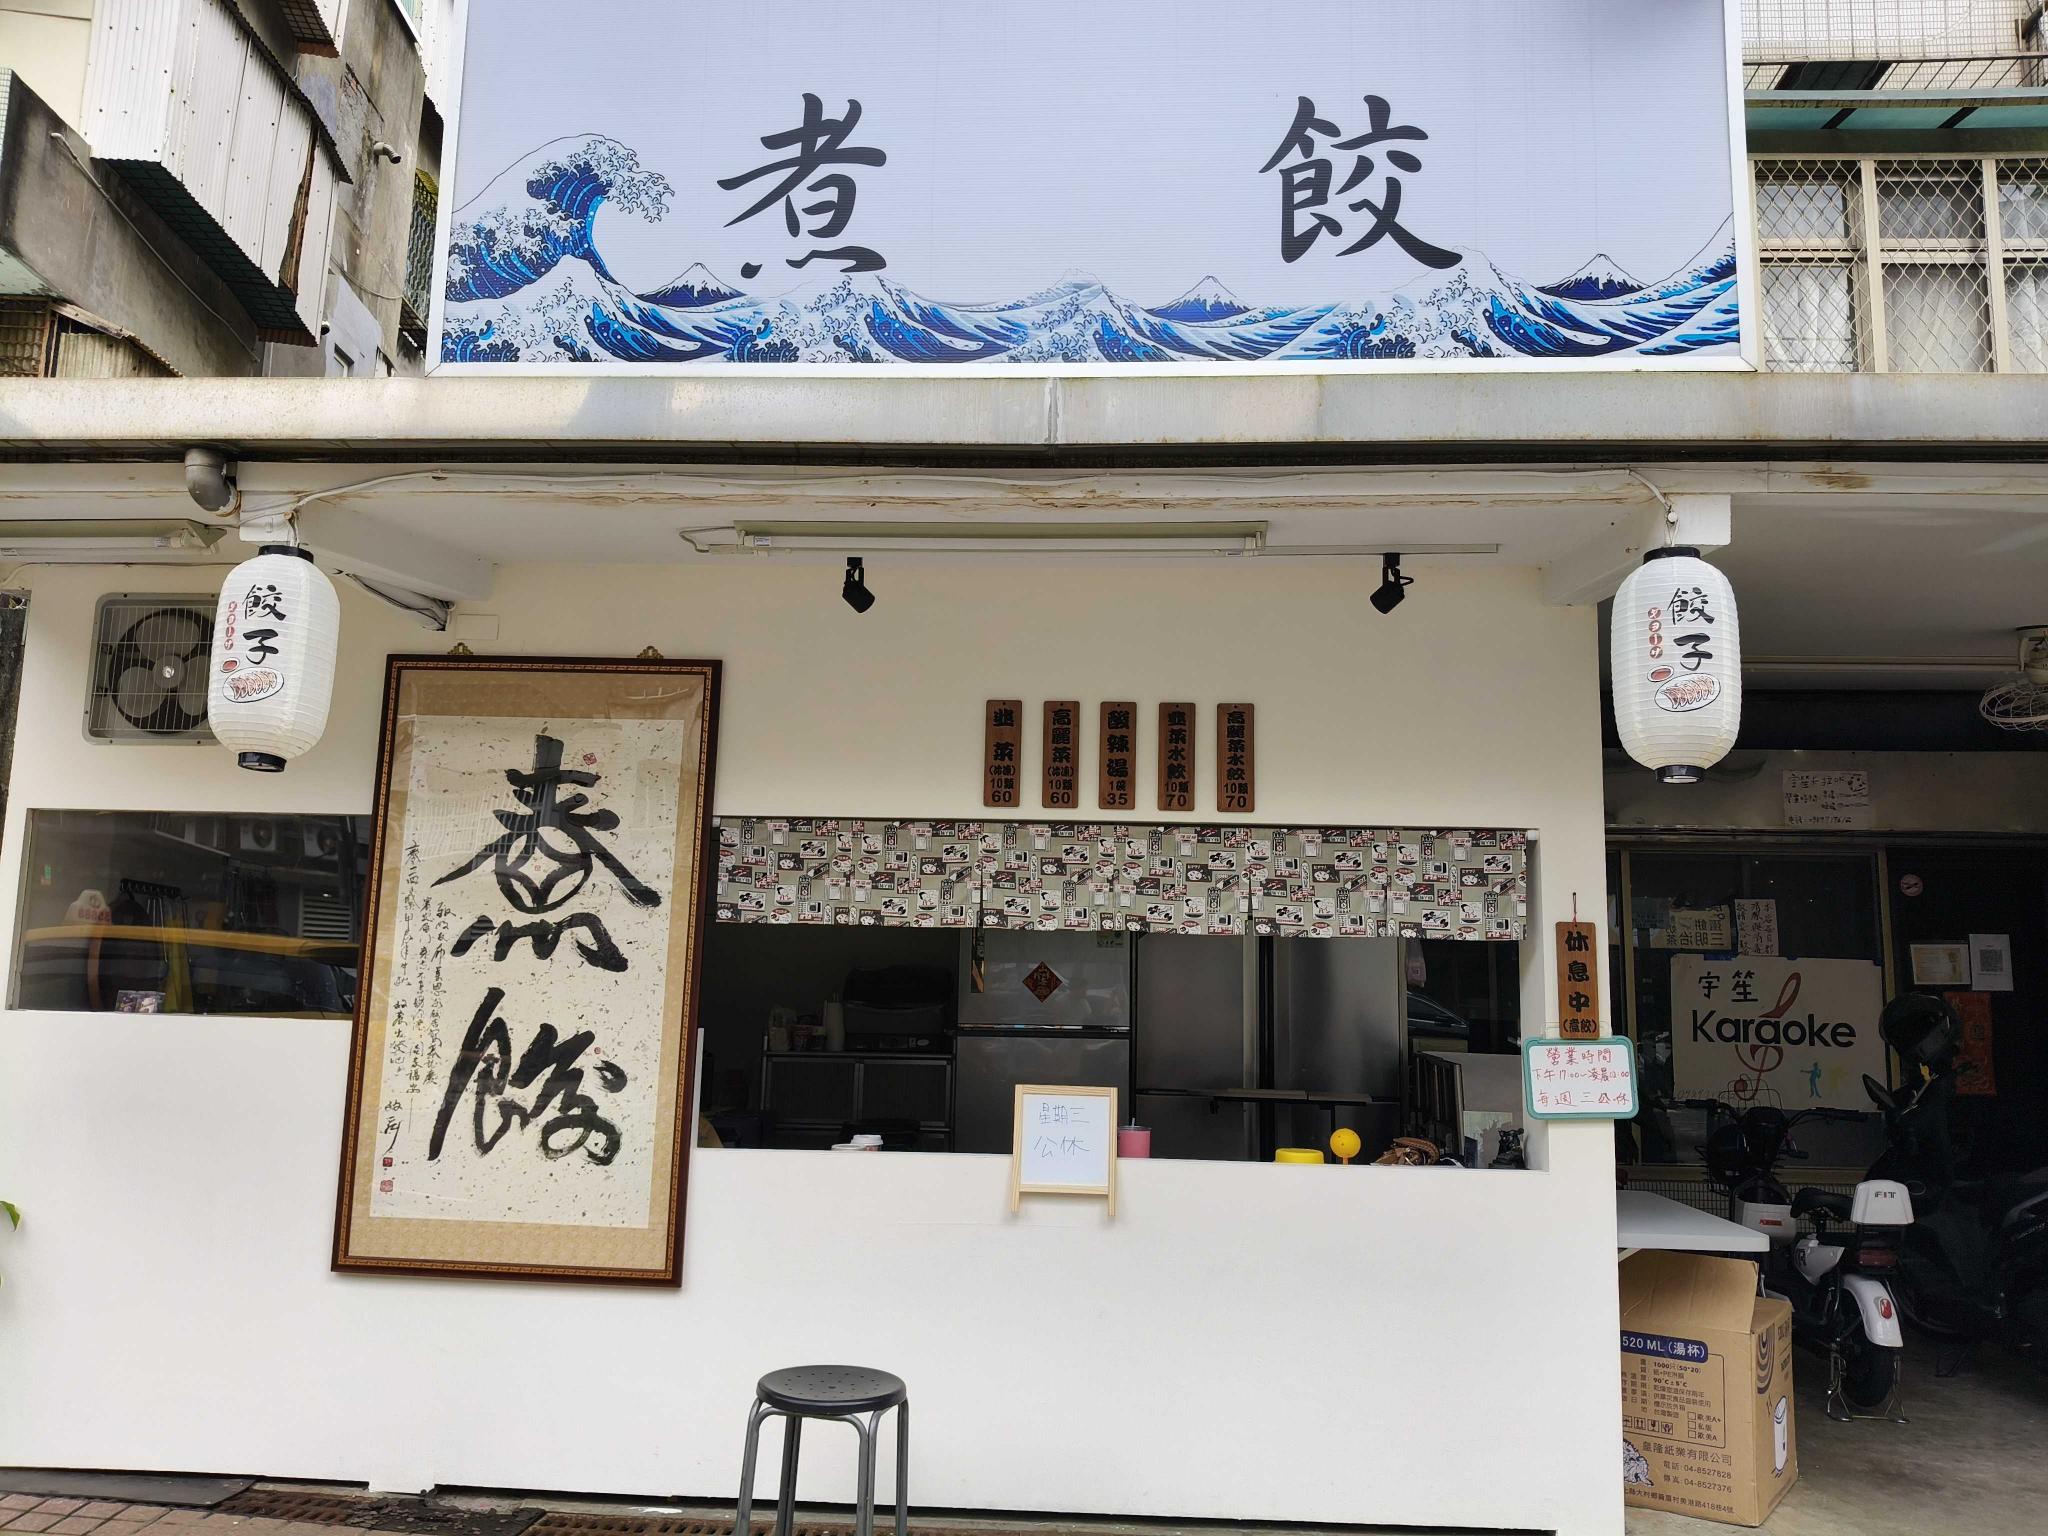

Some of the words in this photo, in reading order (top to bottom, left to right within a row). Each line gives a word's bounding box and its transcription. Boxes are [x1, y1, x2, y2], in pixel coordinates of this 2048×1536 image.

[718, 92, 888, 275] 煮
[1259, 92, 1463, 270] 餃
[242, 583, 287, 666] 餃子
[1667, 586, 1715, 672] 餃子
[991, 791, 1012, 803] 60
[1050, 791, 1071, 804] 60
[1107, 792, 1128, 806] 35
[1166, 794, 1187, 807] 70
[1226, 795, 1247, 808] 70
[1565, 930, 1590, 1013] 休息中
[1698, 969, 1759, 1003] 宇笙
[1691, 1009, 1857, 1048] Karaoke
[1546, 1047, 1612, 1066] 營業時間
[1039, 1102, 1091, 1124] 星期三
[1034, 1135, 1091, 1158] 公休
[1646, 1340, 1665, 1352] ML
